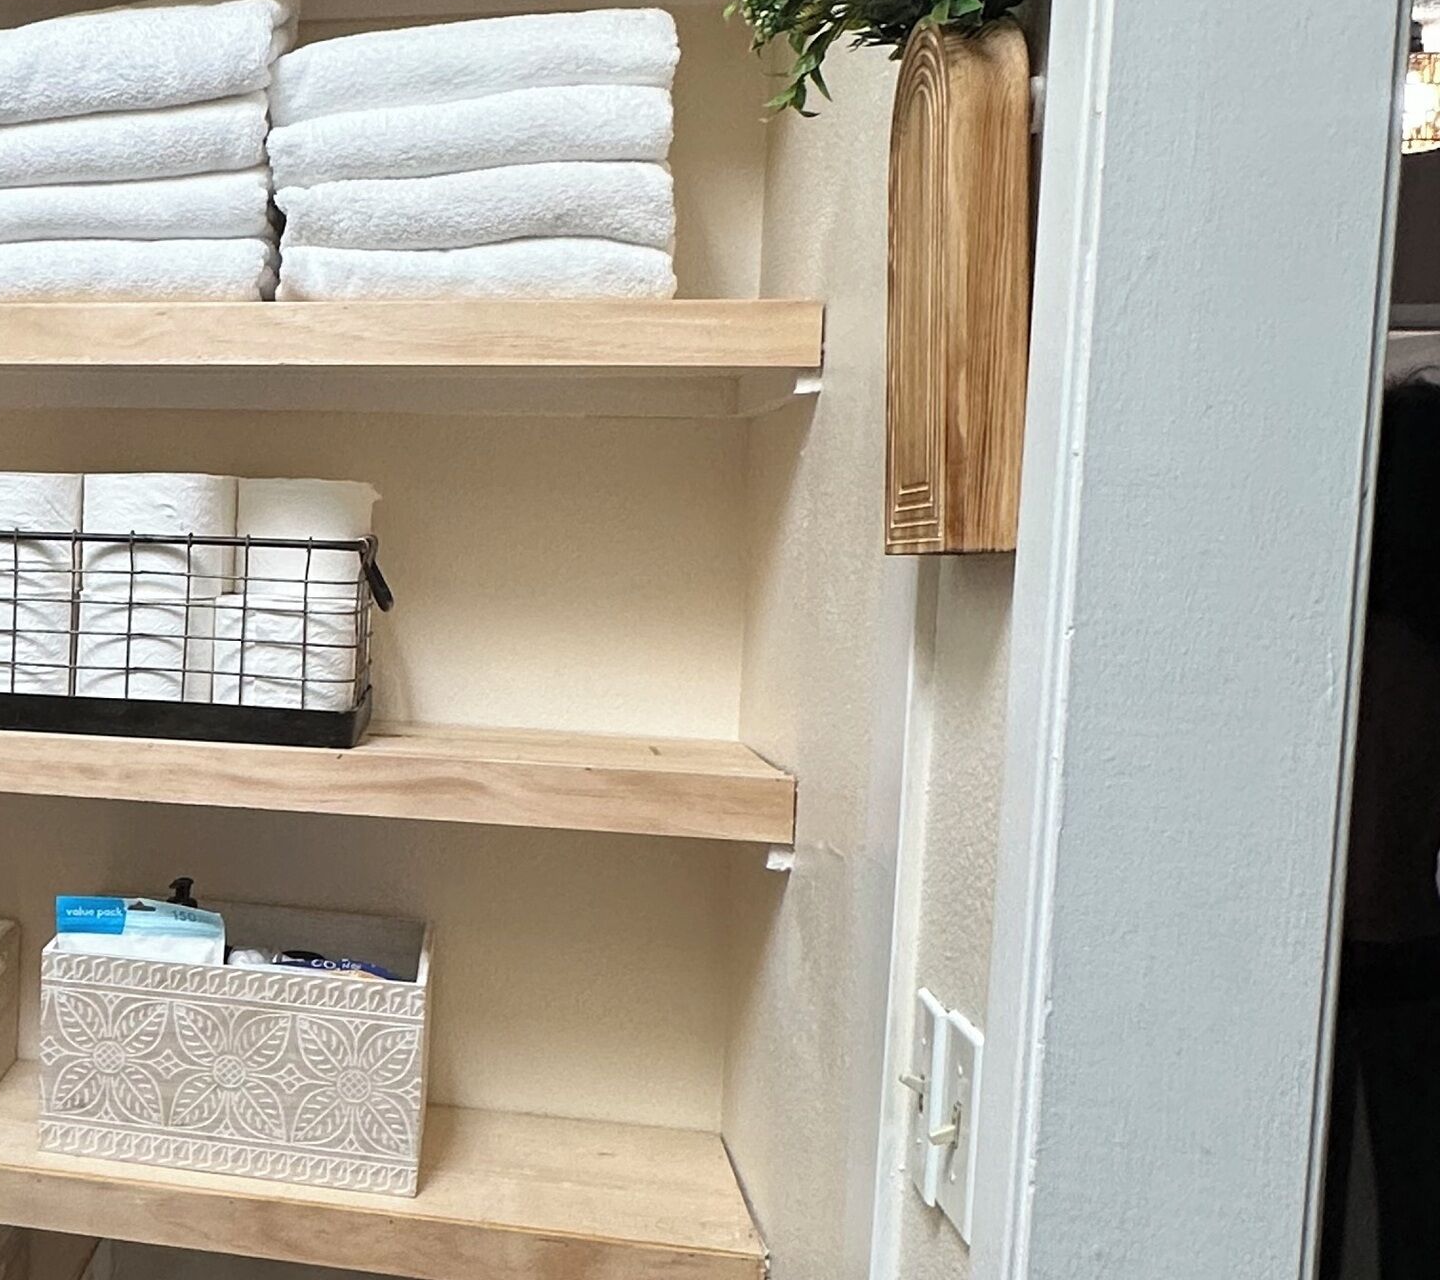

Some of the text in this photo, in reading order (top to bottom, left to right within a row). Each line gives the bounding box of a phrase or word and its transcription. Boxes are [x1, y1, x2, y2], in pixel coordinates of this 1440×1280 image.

[65, 907, 123, 918] value pack
[172, 910, 197, 922] 150
